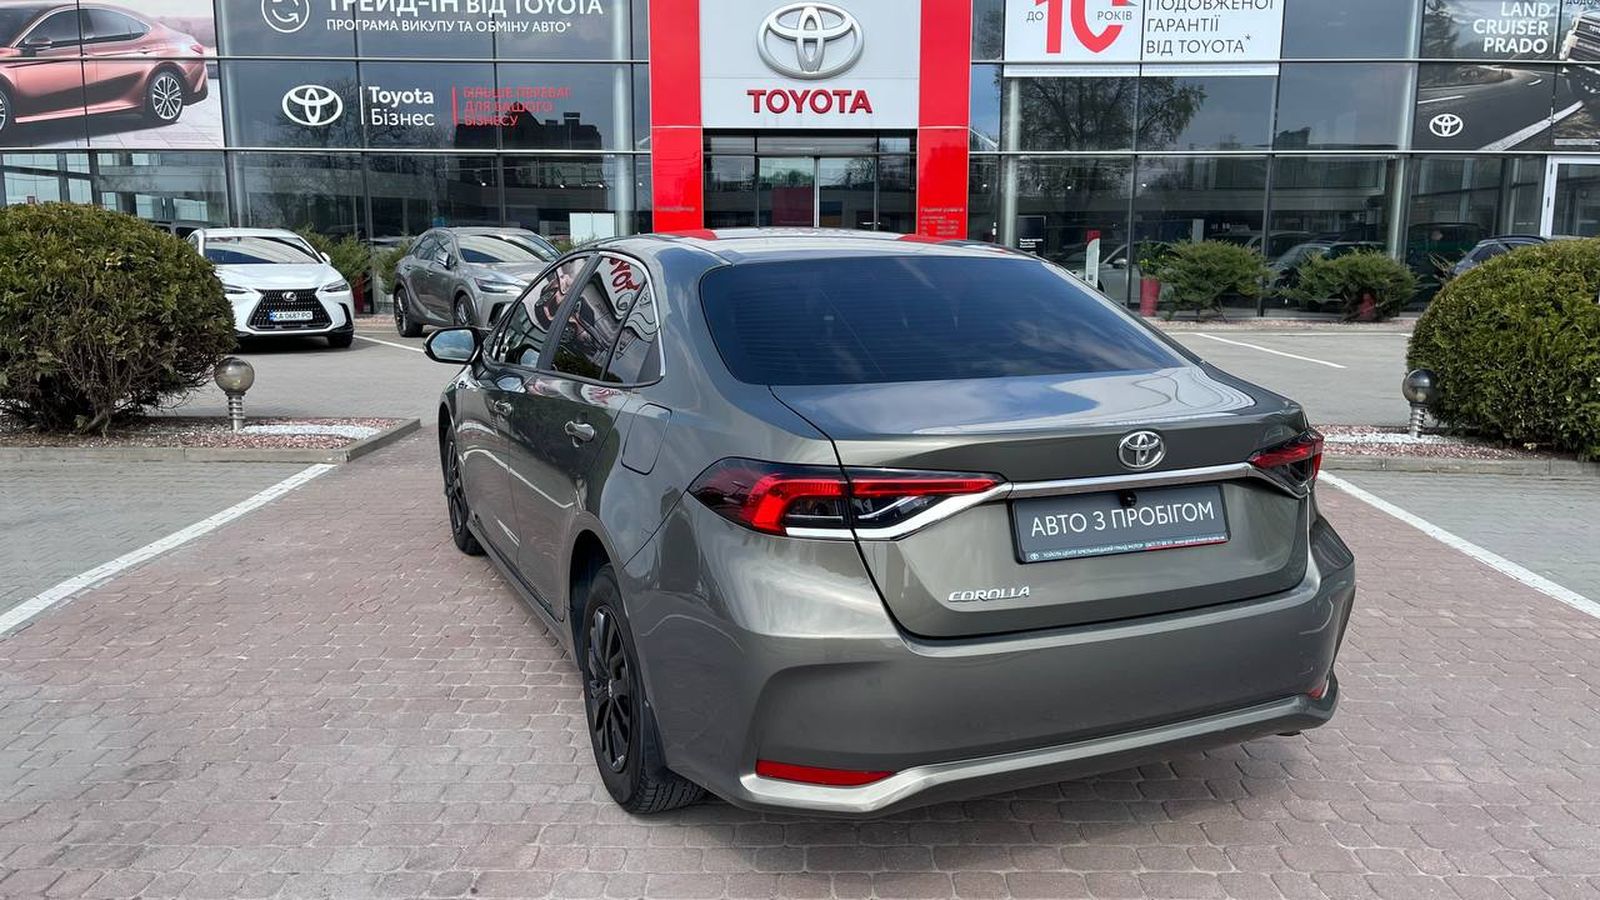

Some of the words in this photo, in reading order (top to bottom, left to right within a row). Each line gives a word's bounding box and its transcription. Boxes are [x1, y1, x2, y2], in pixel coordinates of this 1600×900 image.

[1026, 10, 1045, 23] ДО
[1096, 10, 1133, 21] РОКІВ
[1501, 2, 1550, 17] LAND
[326, 19, 399, 31] ПРОГРАМА
[401, 20, 455, 32] ВИКУПУ
[457, 21, 474, 32] ТА
[475, 21, 529, 32] ОБМІНУ
[1147, 14, 1221, 32] ГАРАНТІЇ
[1473, 18, 1549, 36] CRUISER
[1146, 39, 1173, 56] ВІД
[1483, 36, 1548, 54] PRADO
[368, 86, 434, 108] Toyota
[747, 89, 873, 114] TOYOTA
[371, 108, 435, 126] Бізнес
[1031, 513, 1087, 537] АВТО
[1111, 501, 1215, 529] ПРОБІГОМ
[948, 586, 1031, 601] COROLLA
